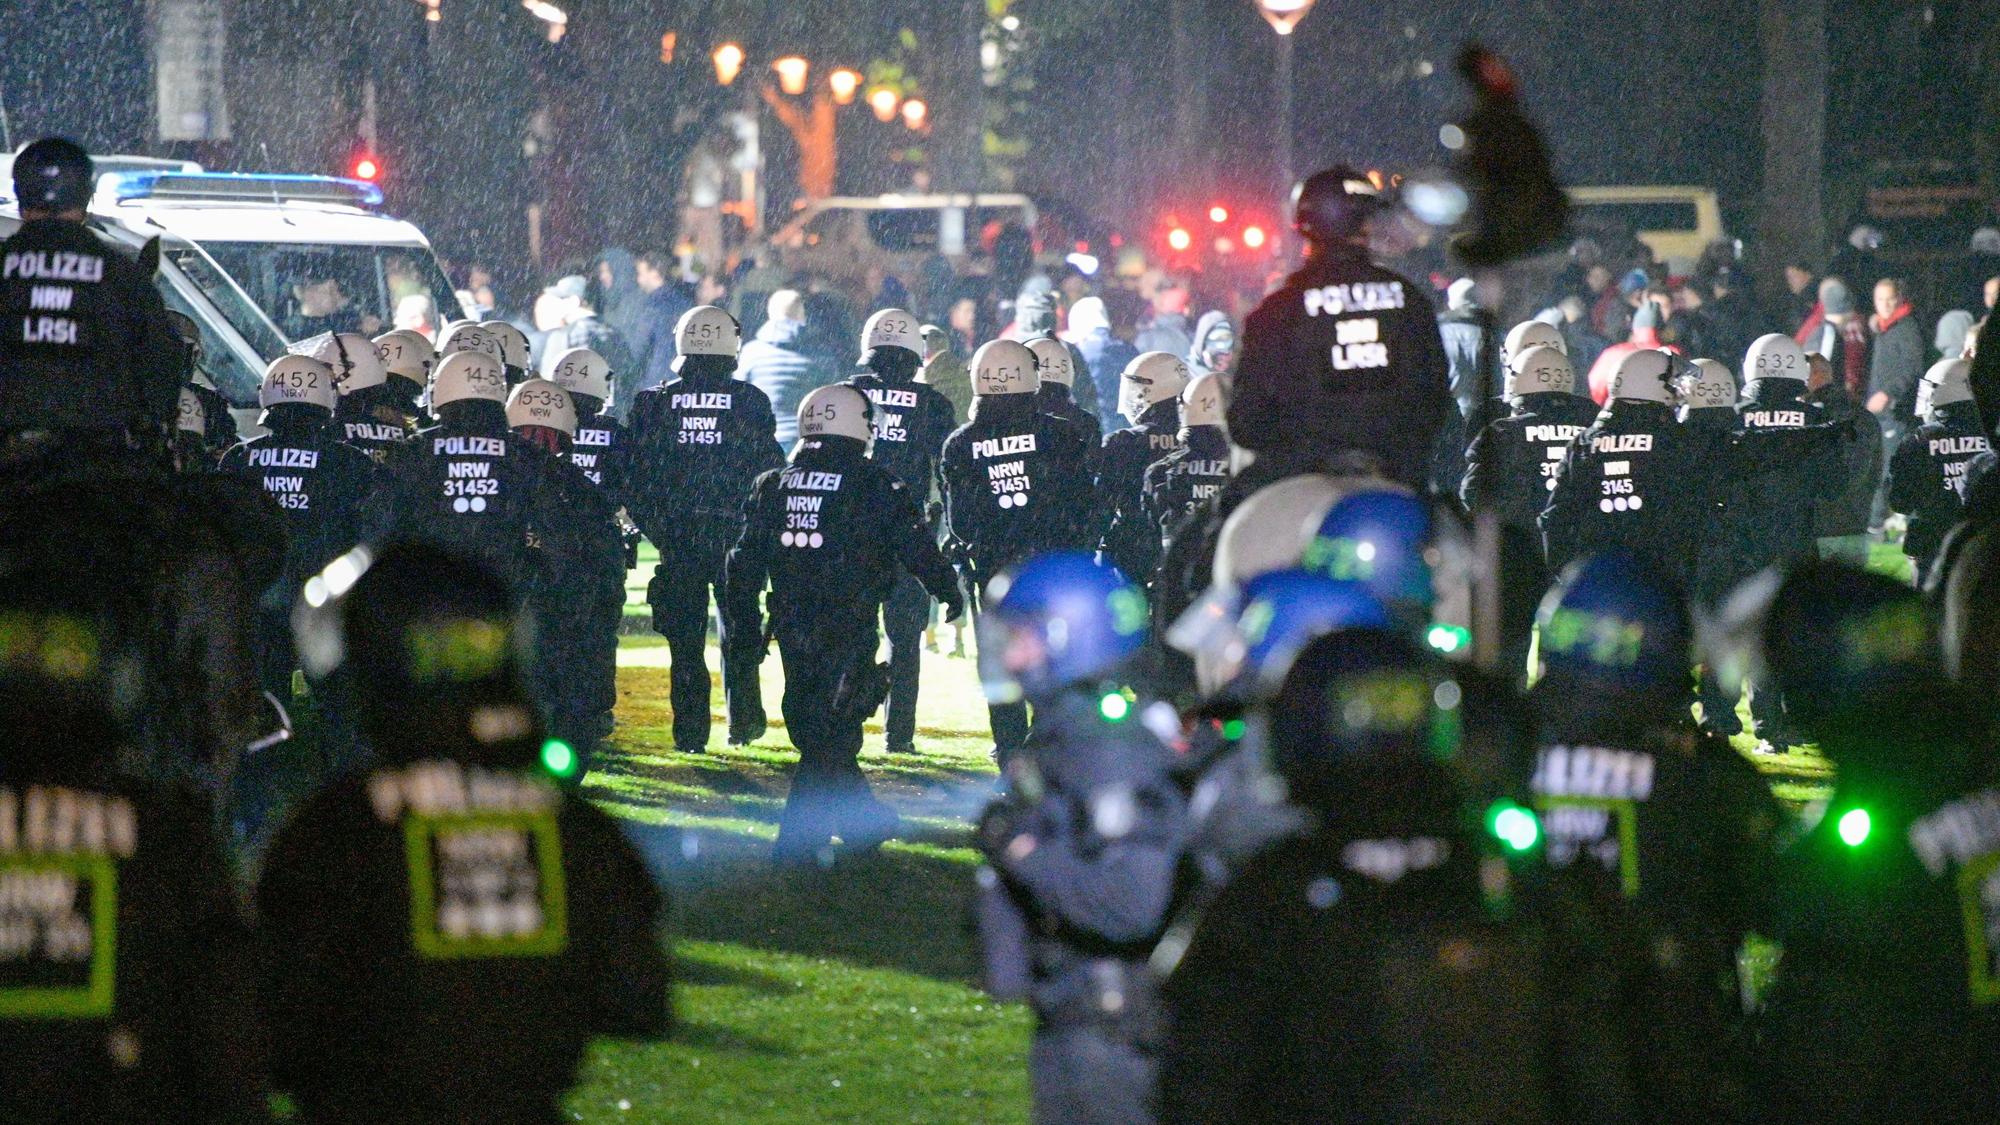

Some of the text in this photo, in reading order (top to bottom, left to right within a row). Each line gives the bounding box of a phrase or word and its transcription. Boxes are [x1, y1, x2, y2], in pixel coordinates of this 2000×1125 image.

[3, 251, 103, 282] POLIZEI
[671, 394, 732, 410] POLIZEI
[529, 408, 550, 418] NRW
[1744, 411, 1804, 426] POLIZEI
[682, 417, 717, 430] NRW
[678, 431, 722, 444] 31451
[1592, 435, 1653, 454] POLIZEI
[434, 437, 506, 457] POLIZEI
[972, 434, 1036, 459] POLIZEI
[248, 448, 318, 469] POLIZEI
[448, 463, 491, 478] NRW
[987, 461, 1025, 480] NRW
[263, 476, 303, 492] NRW
[443, 479, 499, 496] 31452
[778, 472, 842, 491] POLIZEI
[990, 479, 1031, 494] 31451
[1601, 479, 1634, 495] 3145
[786, 495, 823, 513] NRW
[786, 514, 819, 529] 3145
